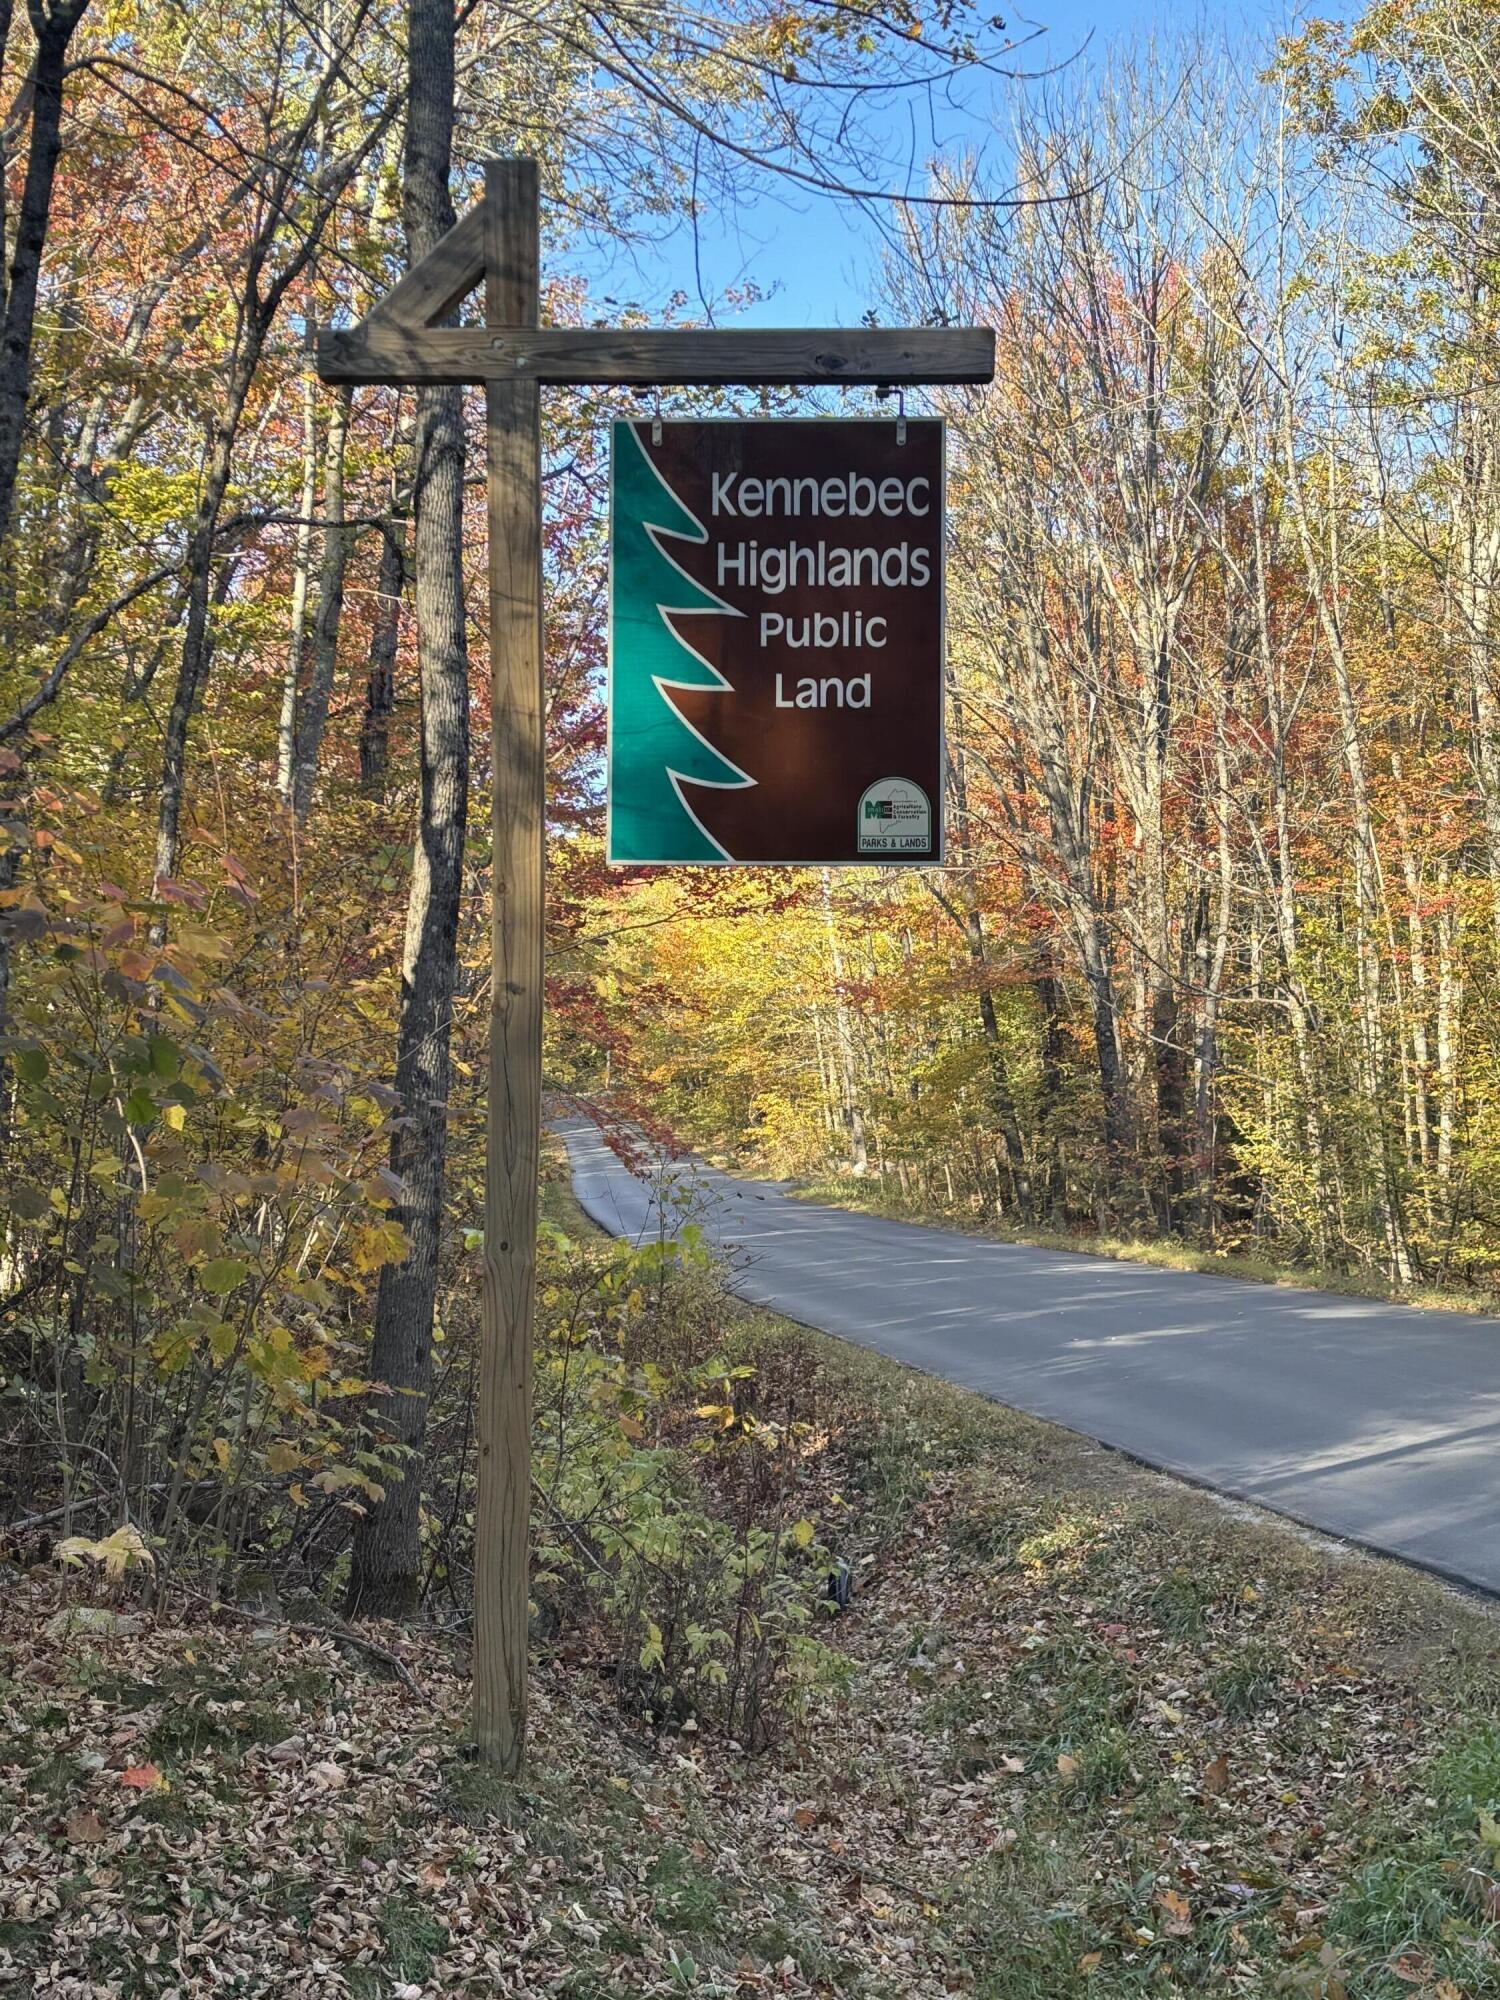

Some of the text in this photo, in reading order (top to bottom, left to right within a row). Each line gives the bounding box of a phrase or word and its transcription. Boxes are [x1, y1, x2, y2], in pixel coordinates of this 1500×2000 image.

[711, 471, 930, 517] Kennebec
[717, 540, 931, 595] Highlands
[760, 611, 887, 648] Public
[775, 673, 871, 709] Land
[862, 838, 927, 848] PARKS & LANDS
